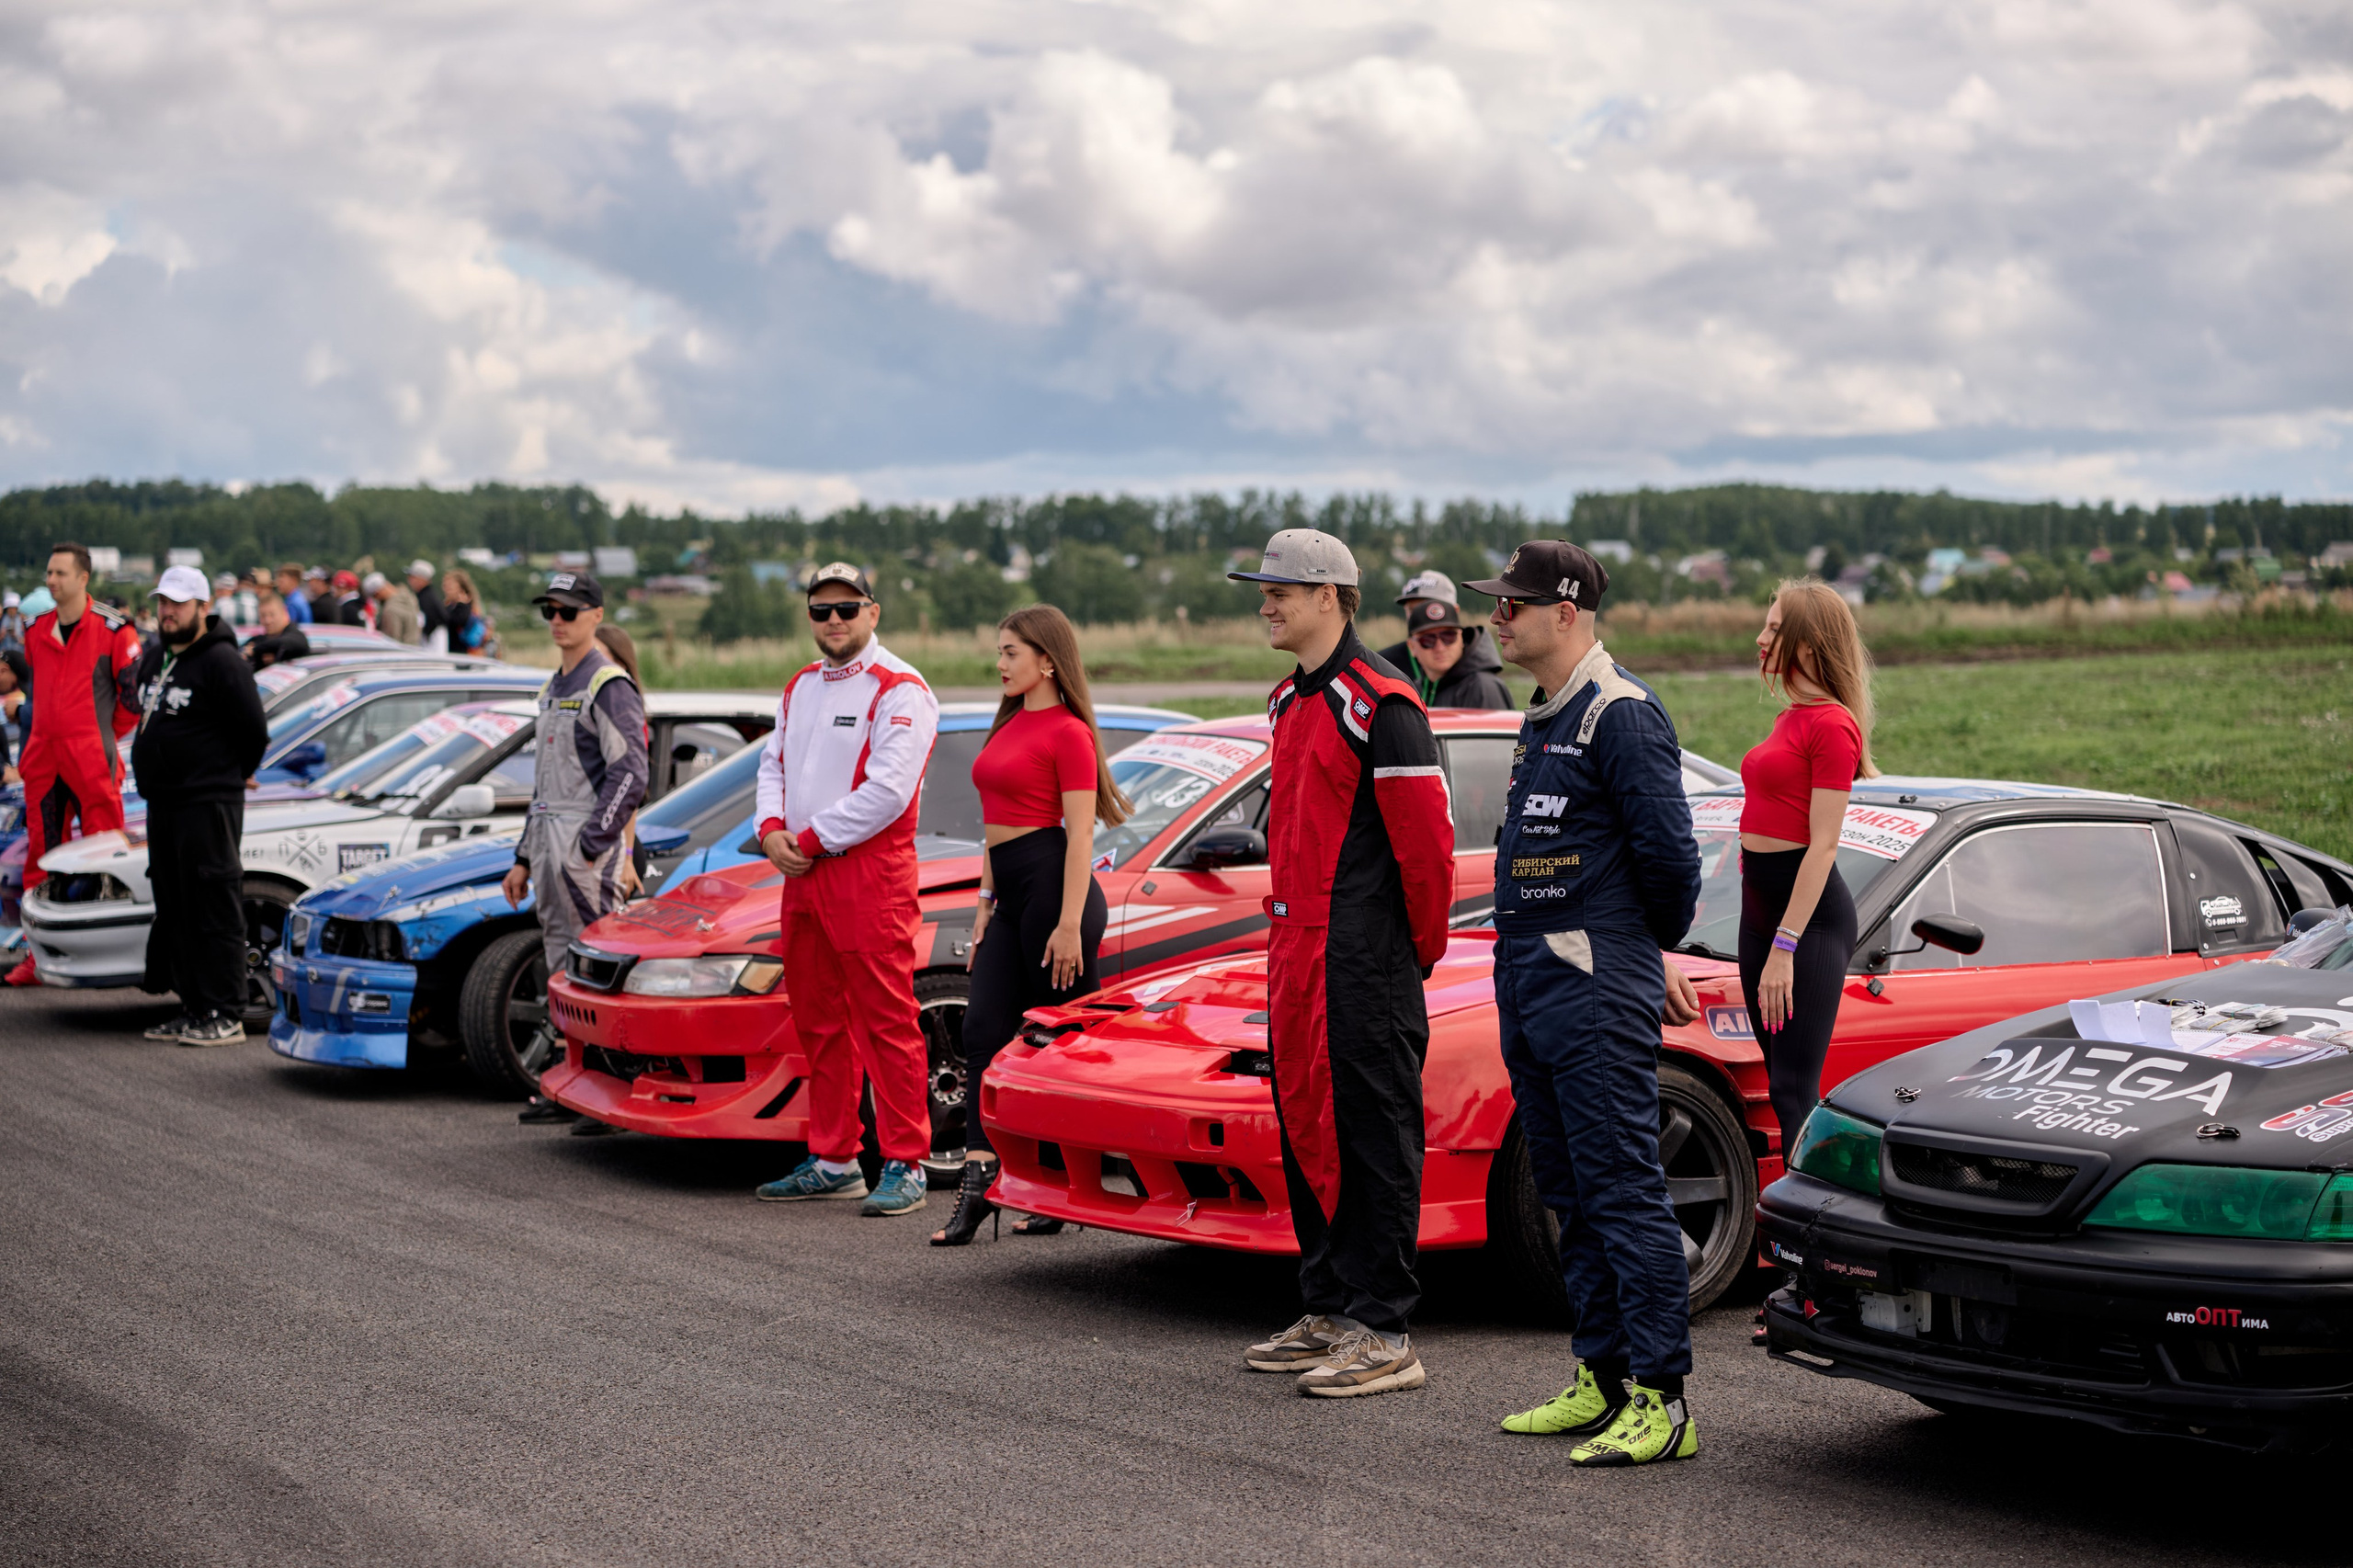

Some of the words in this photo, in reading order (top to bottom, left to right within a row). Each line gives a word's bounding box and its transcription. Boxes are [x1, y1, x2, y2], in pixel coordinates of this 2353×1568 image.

[1557, 577, 1580, 599] 44
[1355, 700, 1370, 716] OMP
[1550, 744, 1583, 756] Valvoline
[1522, 794, 1569, 818] SCW
[1845, 808, 1929, 838] РАКЕТЫ
[1840, 828, 1871, 841] ЕЗОН
[1867, 835, 1911, 852] 2025
[1511, 867, 1554, 877] КАРДАН
[1512, 855, 1580, 868] СИБИРСКИЙ
[1521, 885, 1566, 899] bronko
[1274, 904, 1287, 914] OMP
[1946, 1045, 2233, 1117] OMEGA
[1949, 1085, 2134, 1115] MOTORS
[2012, 1105, 2140, 1140] Fighter
[2309, 1116, 2353, 1142] Supr
[1779, 1248, 1803, 1266] Valvoline
